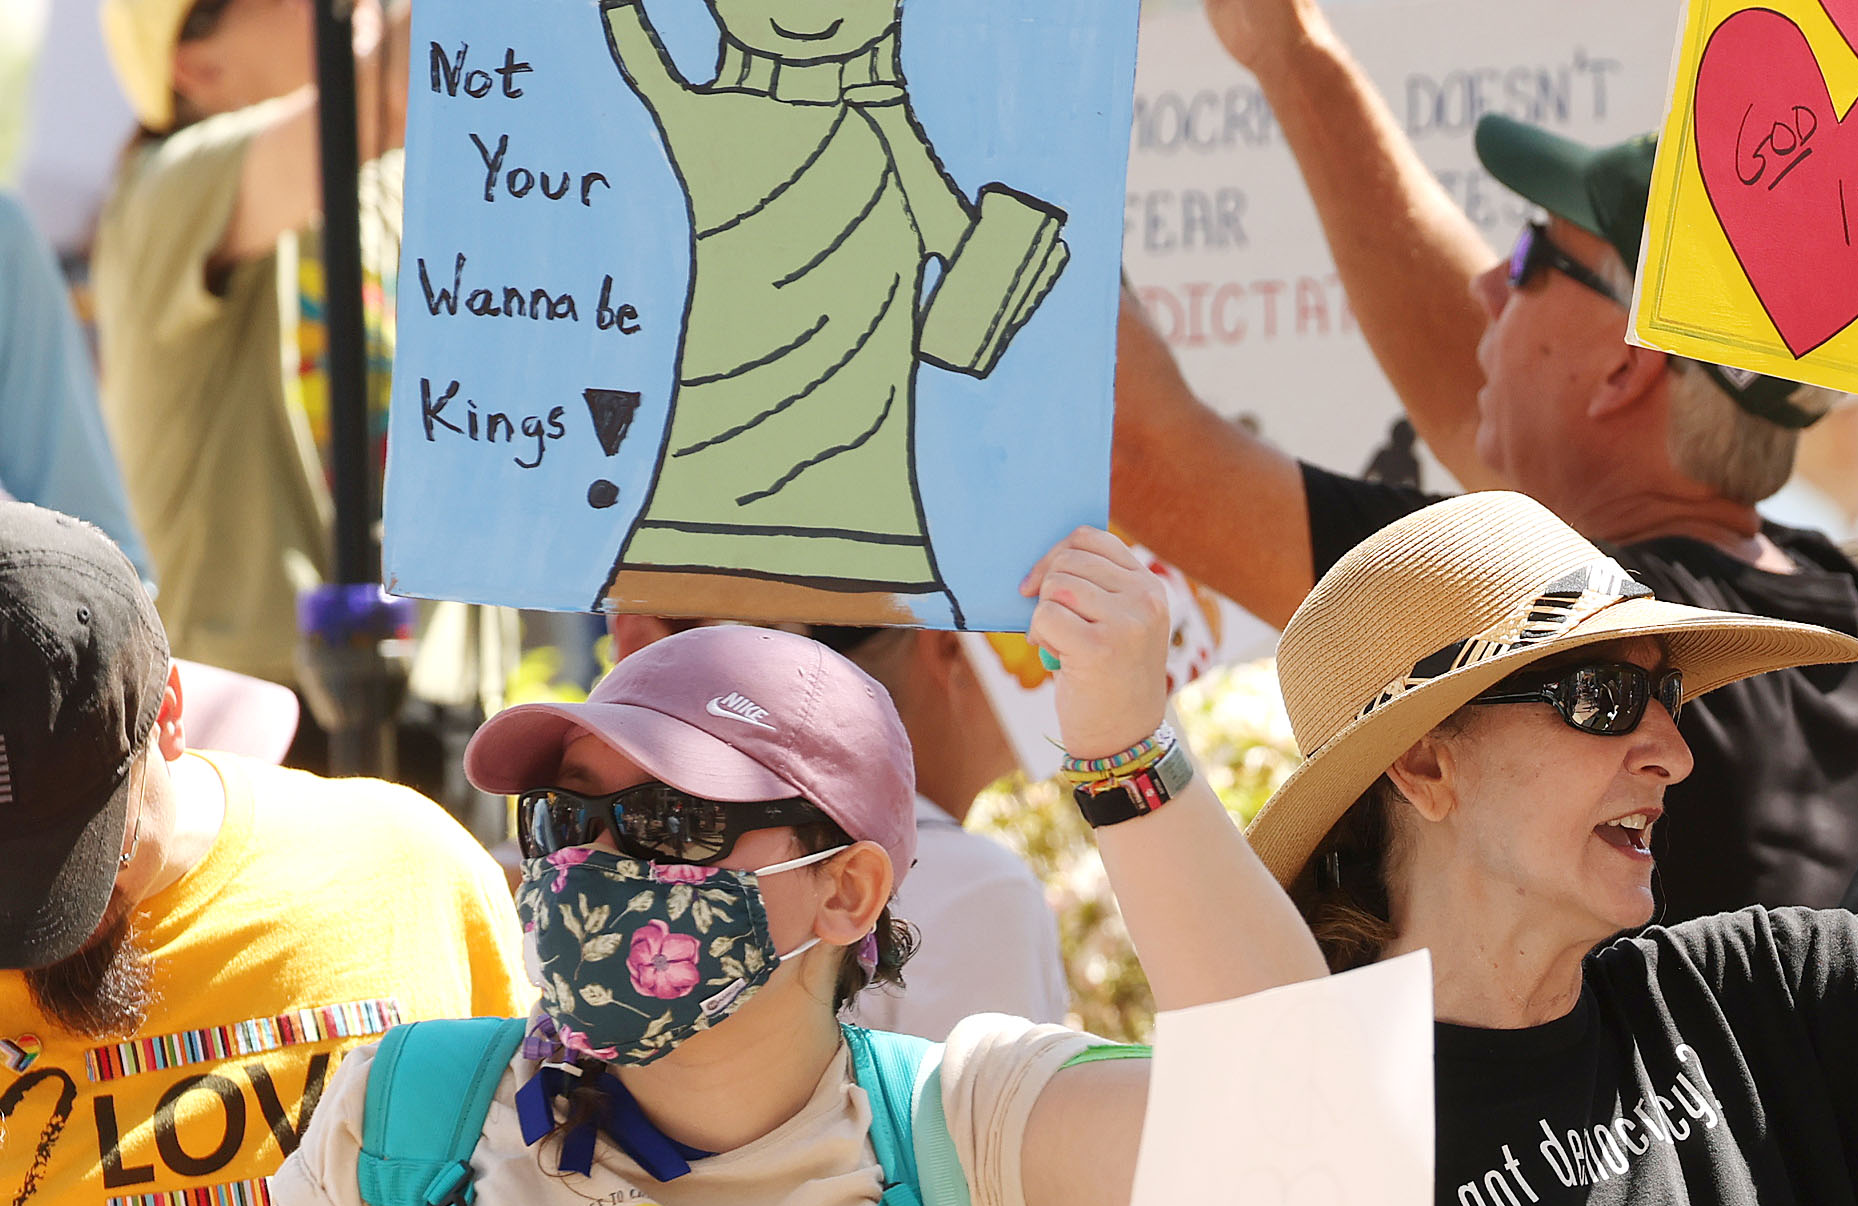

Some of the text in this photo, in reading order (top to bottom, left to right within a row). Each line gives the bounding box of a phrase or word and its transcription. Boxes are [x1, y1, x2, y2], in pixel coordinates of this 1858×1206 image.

[430, 41, 534, 98] Not
[469, 133, 611, 207] Your
[1736, 103, 1817, 186] GOD
[721, 691, 769, 722] NIKE
[93, 1050, 348, 1189] LOV
